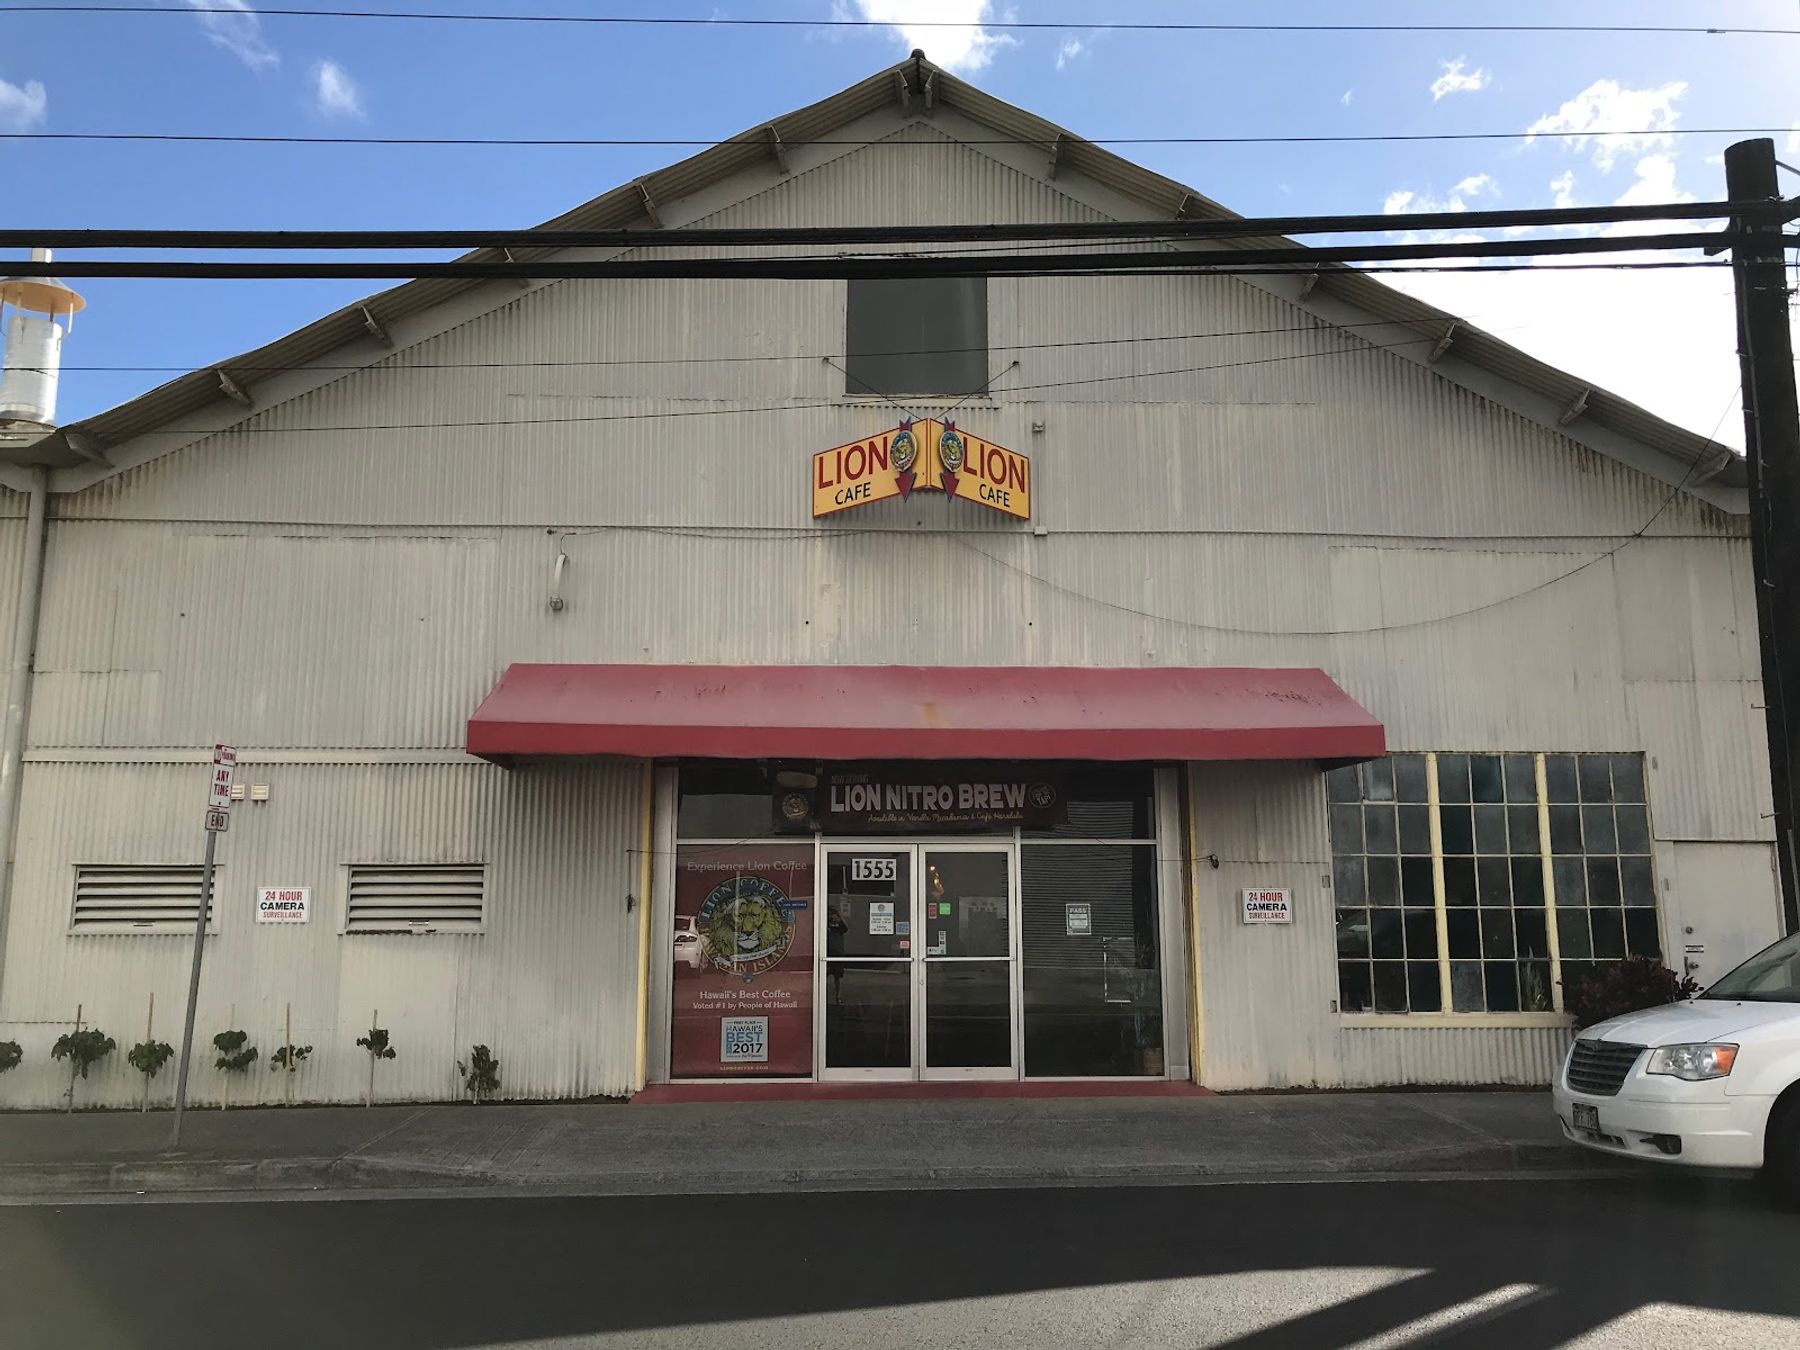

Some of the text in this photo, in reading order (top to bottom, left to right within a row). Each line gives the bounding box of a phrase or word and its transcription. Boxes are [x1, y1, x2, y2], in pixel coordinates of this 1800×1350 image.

[818, 436, 888, 489] LION
[962, 436, 1025, 493] LION
[834, 481, 871, 505] CAFE
[978, 483, 1011, 508] CAFE
[216, 769, 230, 782] ANY
[214, 783, 229, 797] TIME
[830, 784, 881, 813] LION
[886, 783, 954, 811] NITRO
[958, 783, 1026, 809] BREW
[210, 814, 224, 828] END
[687, 860, 808, 873] Experience Lion Coffee
[855, 861, 894, 879] 1555
[265, 891, 303, 901] 24 HOUR
[701, 884, 733, 919] LION
[1248, 891, 1283, 902] 24 HOUR
[260, 902, 305, 911] CAMERA
[1246, 902, 1288, 911] CAMERA
[263, 911, 303, 919] SURVEILLANCE
[700, 990, 791, 1000] Hawaii's Best Coffee
[728, 1002, 737, 1010] by
[738, 1002, 762, 1010] People
[726, 1031, 763, 1043] BEST
[732, 1042, 763, 1054] 2017
